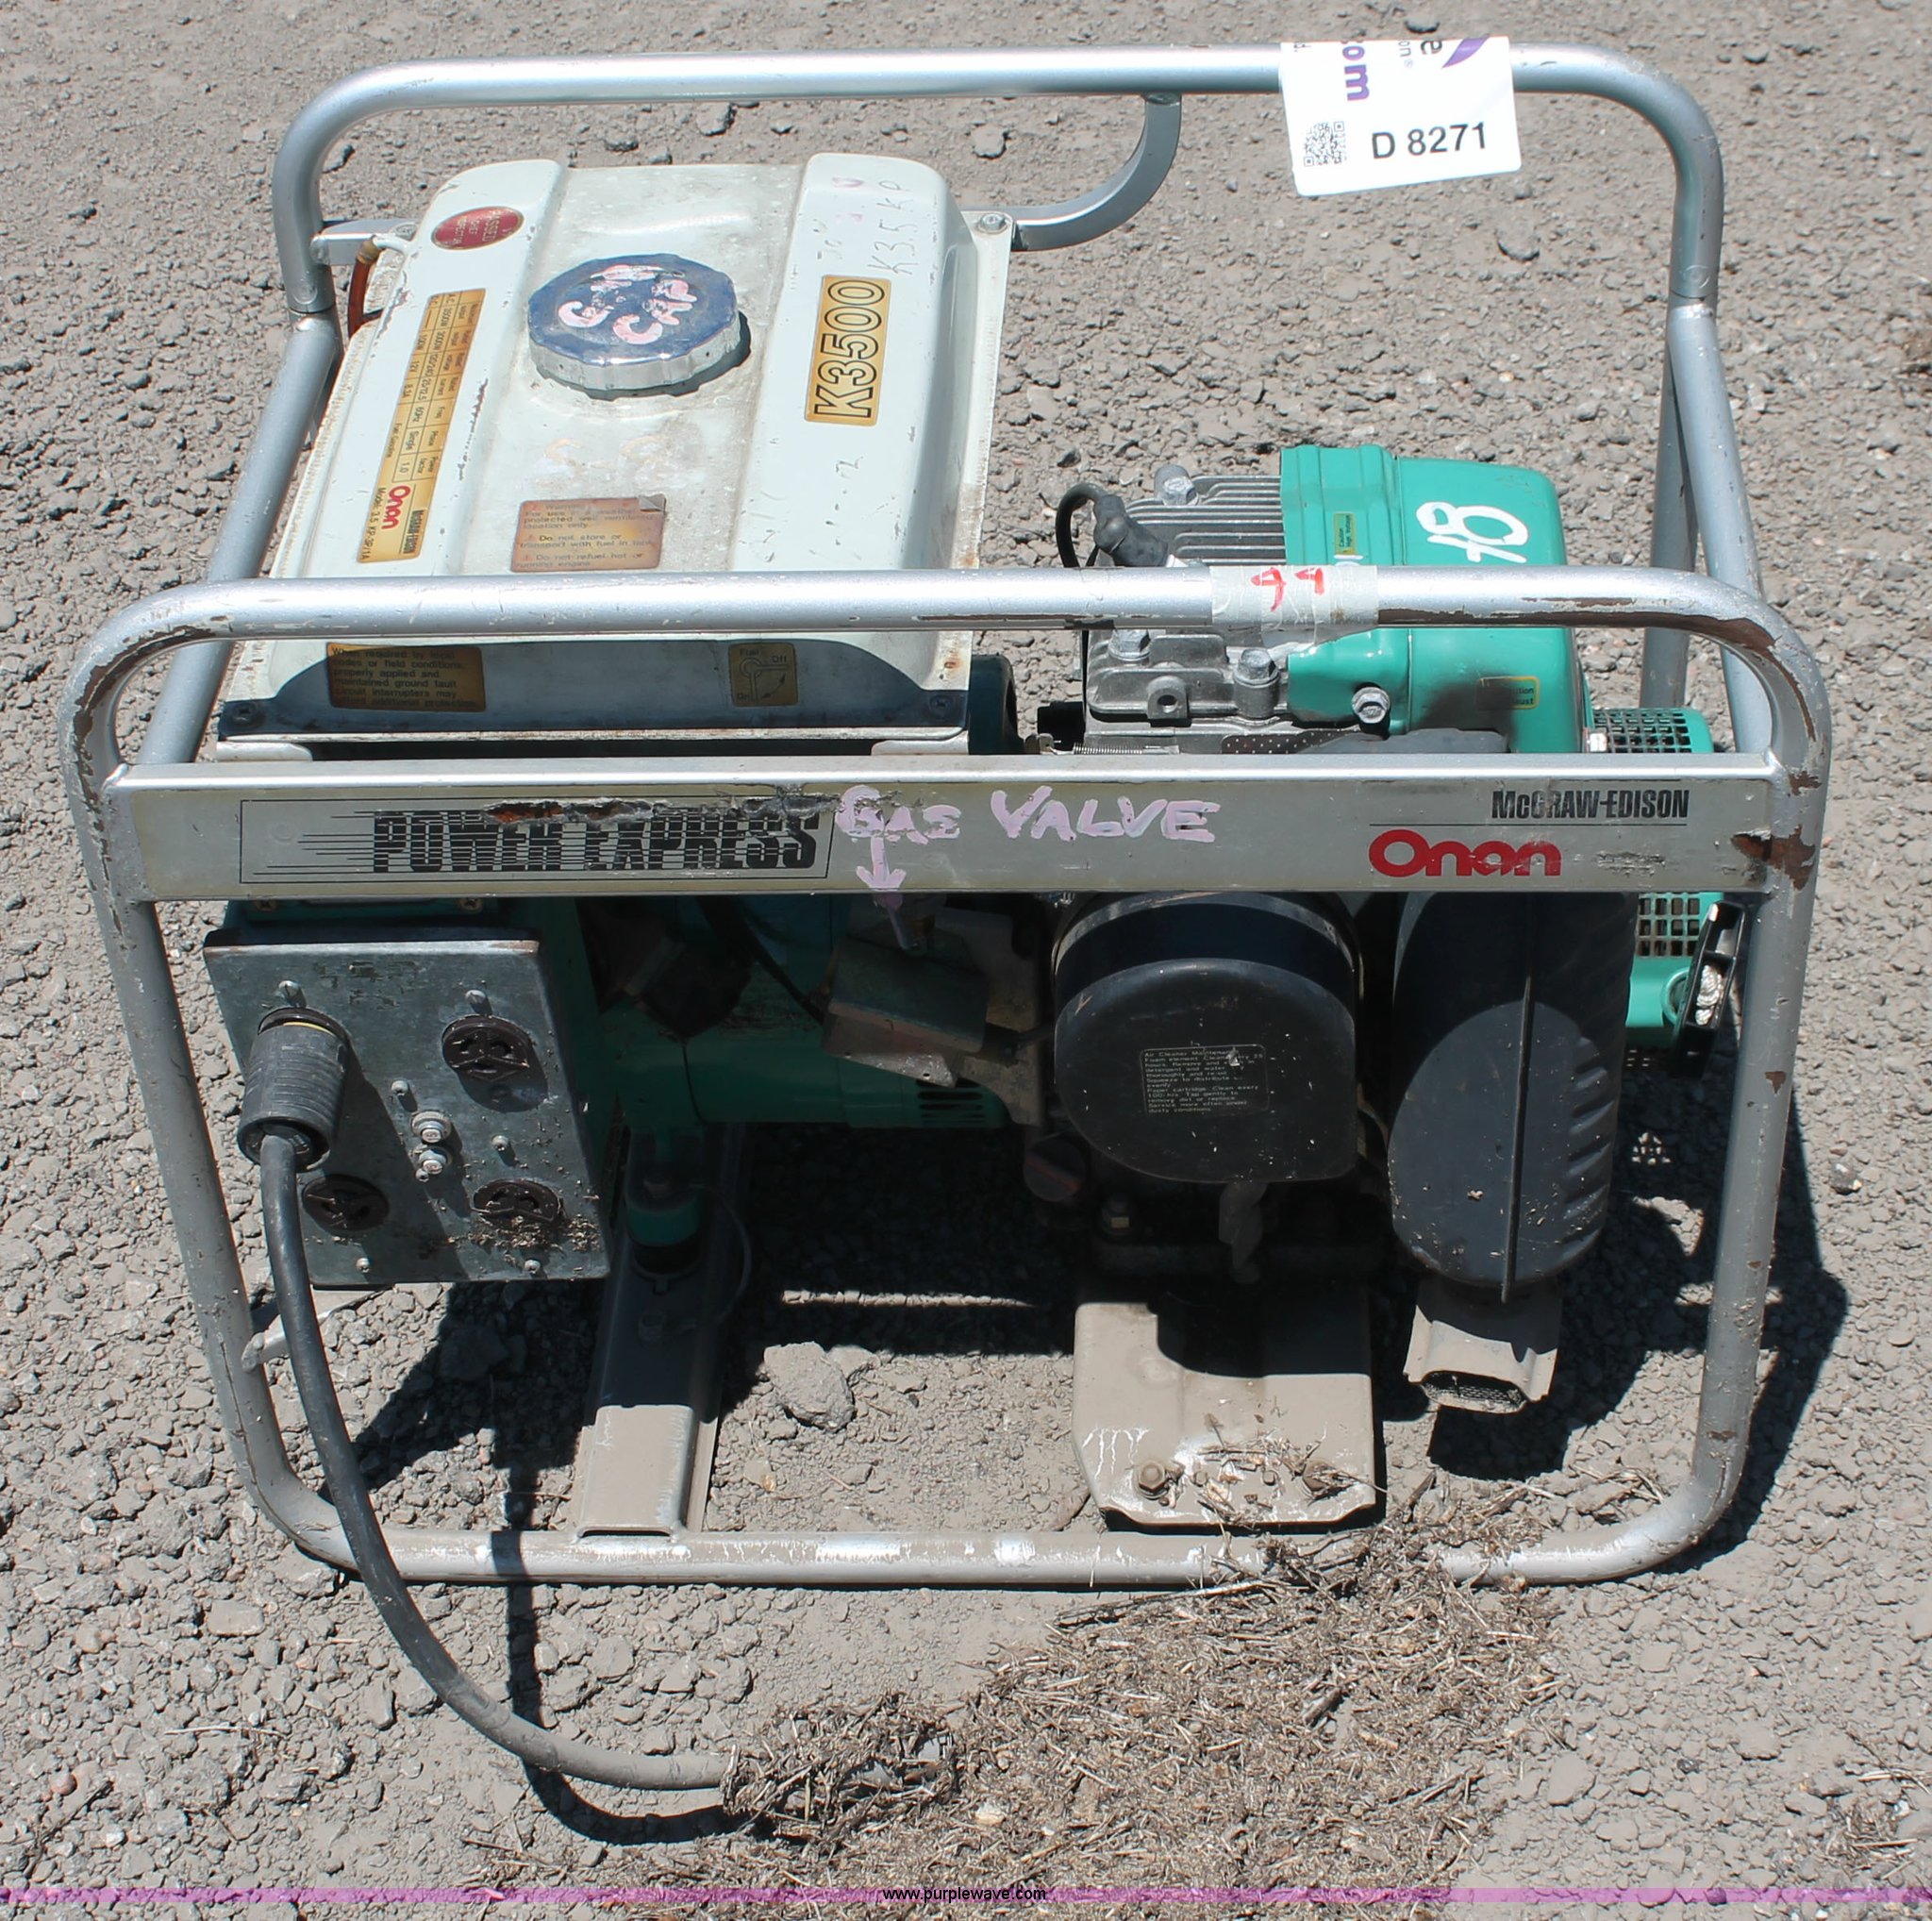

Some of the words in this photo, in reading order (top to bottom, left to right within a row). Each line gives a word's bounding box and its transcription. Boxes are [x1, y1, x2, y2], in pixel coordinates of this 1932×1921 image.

[1372, 131, 1396, 159] D
[1407, 121, 1486, 156] 8271
[814, 279, 885, 418] K3500
[399, 461, 410, 474] 1.0
[380, 485, 411, 529] Onan
[990, 785, 1222, 843] VALVE
[1491, 789, 1690, 819] McGRAW-EDISON
[374, 809, 563, 873] POWER
[585, 808, 819, 873] EXPRESS
[1368, 828, 1562, 877] Onan
